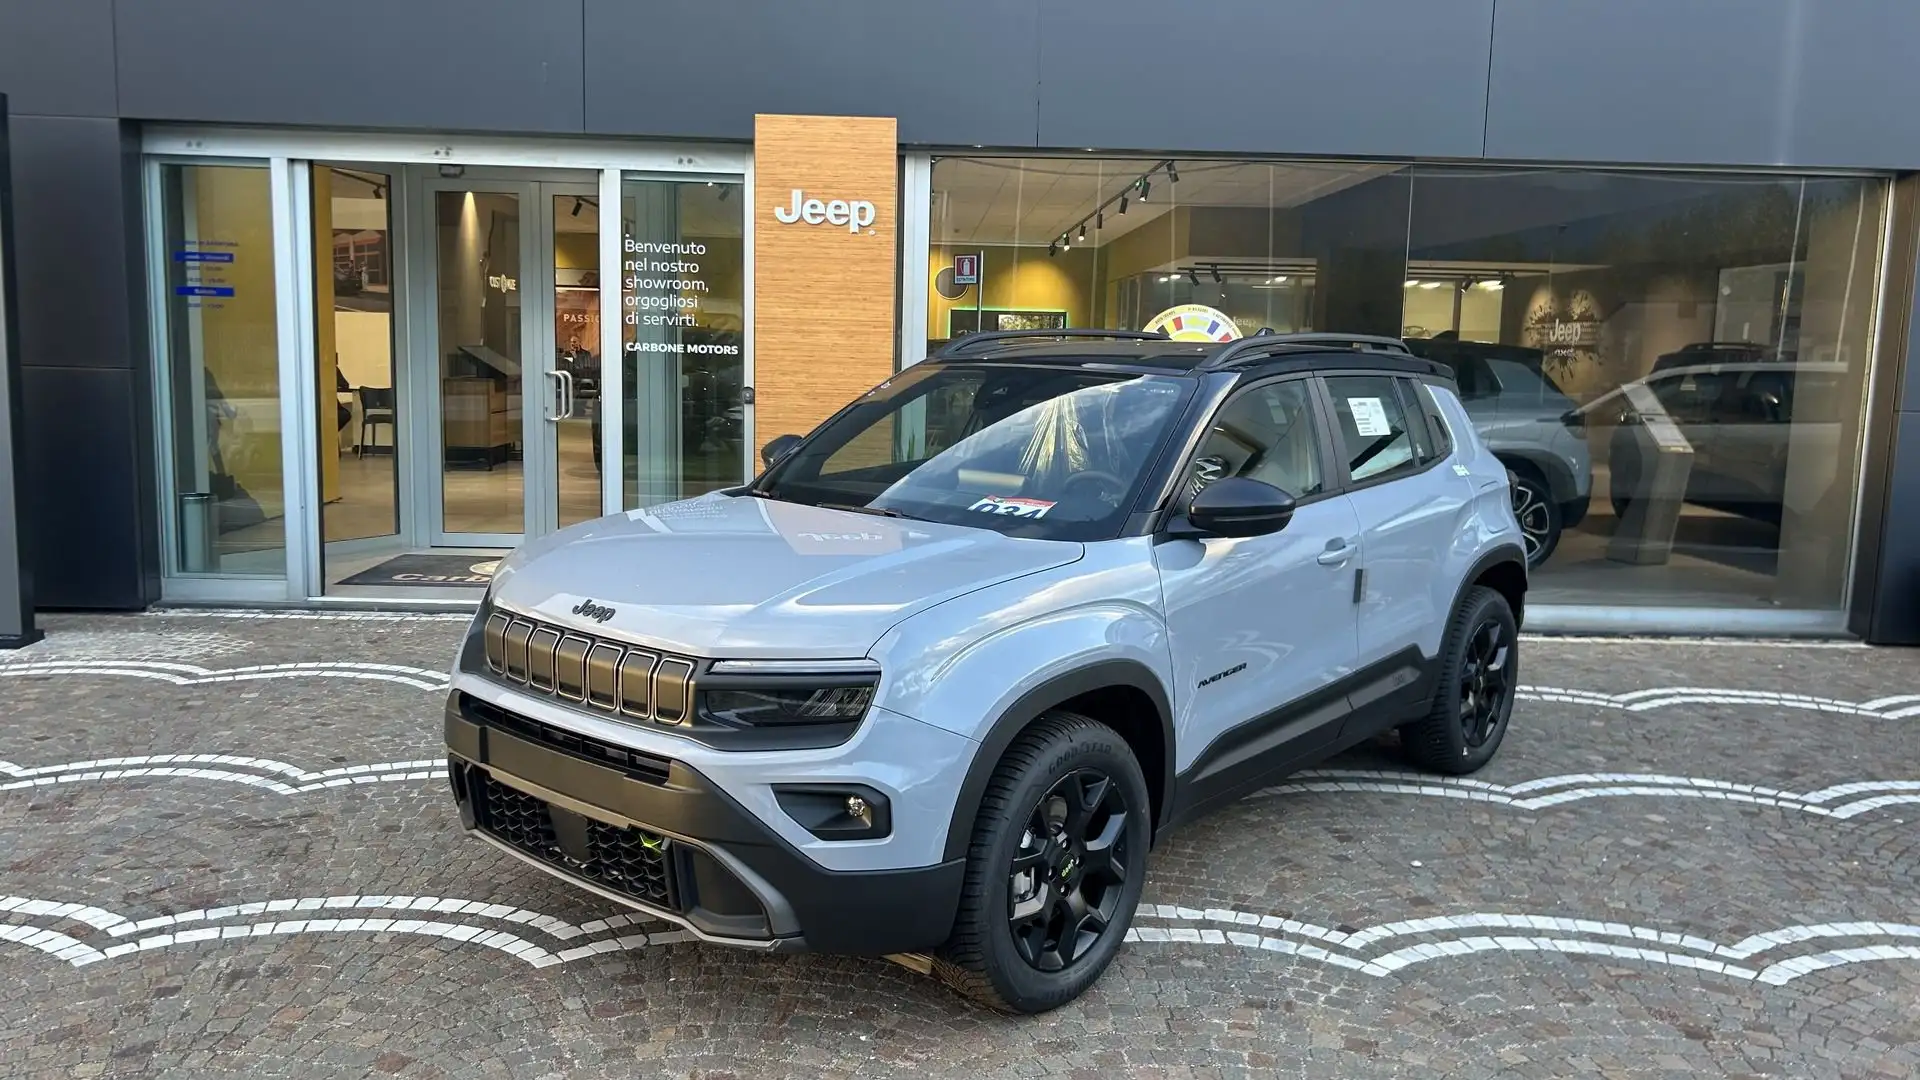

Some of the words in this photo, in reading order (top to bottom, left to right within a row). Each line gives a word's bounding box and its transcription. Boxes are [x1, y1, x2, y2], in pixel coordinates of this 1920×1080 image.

[774, 189, 875, 235] Jeep
[624, 239, 706, 255] Benvenuto
[625, 258, 647, 271] nel
[651, 260, 700, 274] nostro
[625, 275, 709, 293] showroom,
[625, 294, 698, 311] orgogliosi
[625, 311, 639, 325] di
[643, 313, 699, 327] servirti.
[1549, 318, 1581, 346] Jeep
[625, 342, 685, 353] CARBONE
[687, 344, 739, 355] MOTORS
[572, 598, 616, 624] Jeep
[1197, 662, 1247, 689] AVENGER
